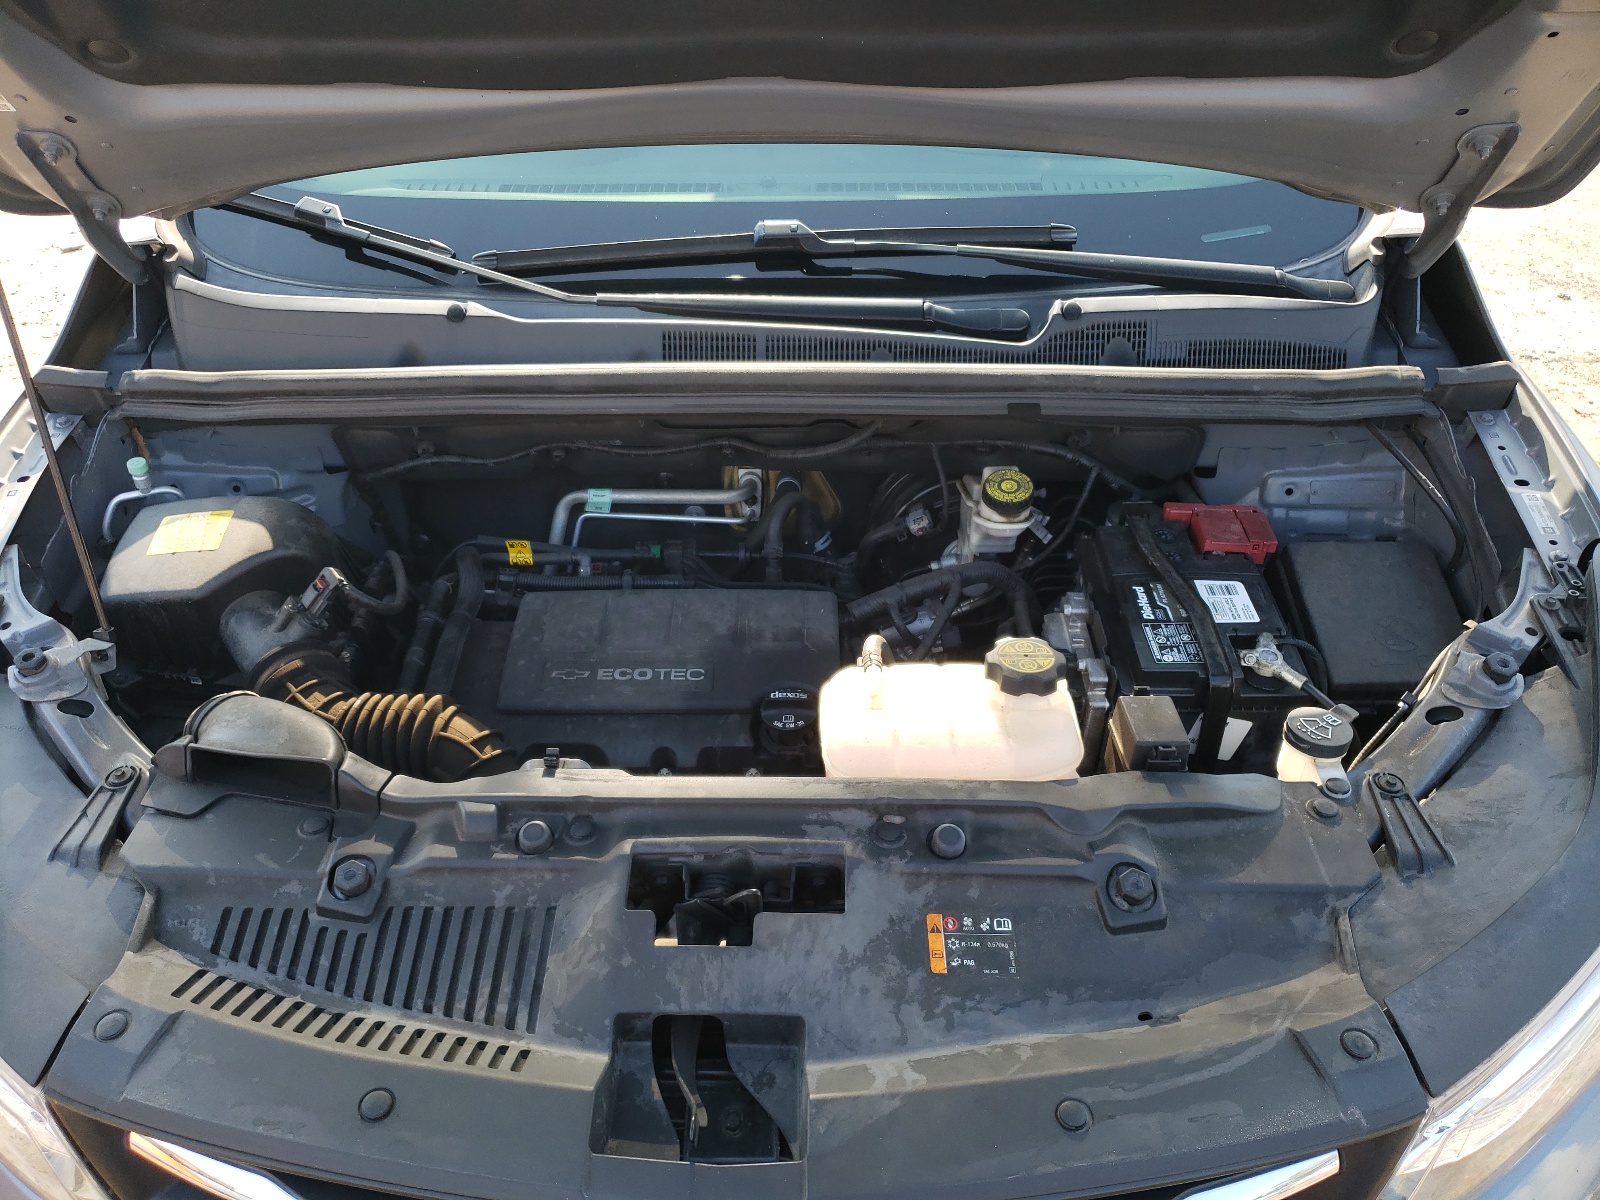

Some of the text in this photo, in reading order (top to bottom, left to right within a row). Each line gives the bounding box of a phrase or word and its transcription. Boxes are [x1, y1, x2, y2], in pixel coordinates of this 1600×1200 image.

[1132, 586, 1155, 620] DieHard
[596, 668, 705, 681] ECOTEC
[770, 691, 808, 699] dexos
